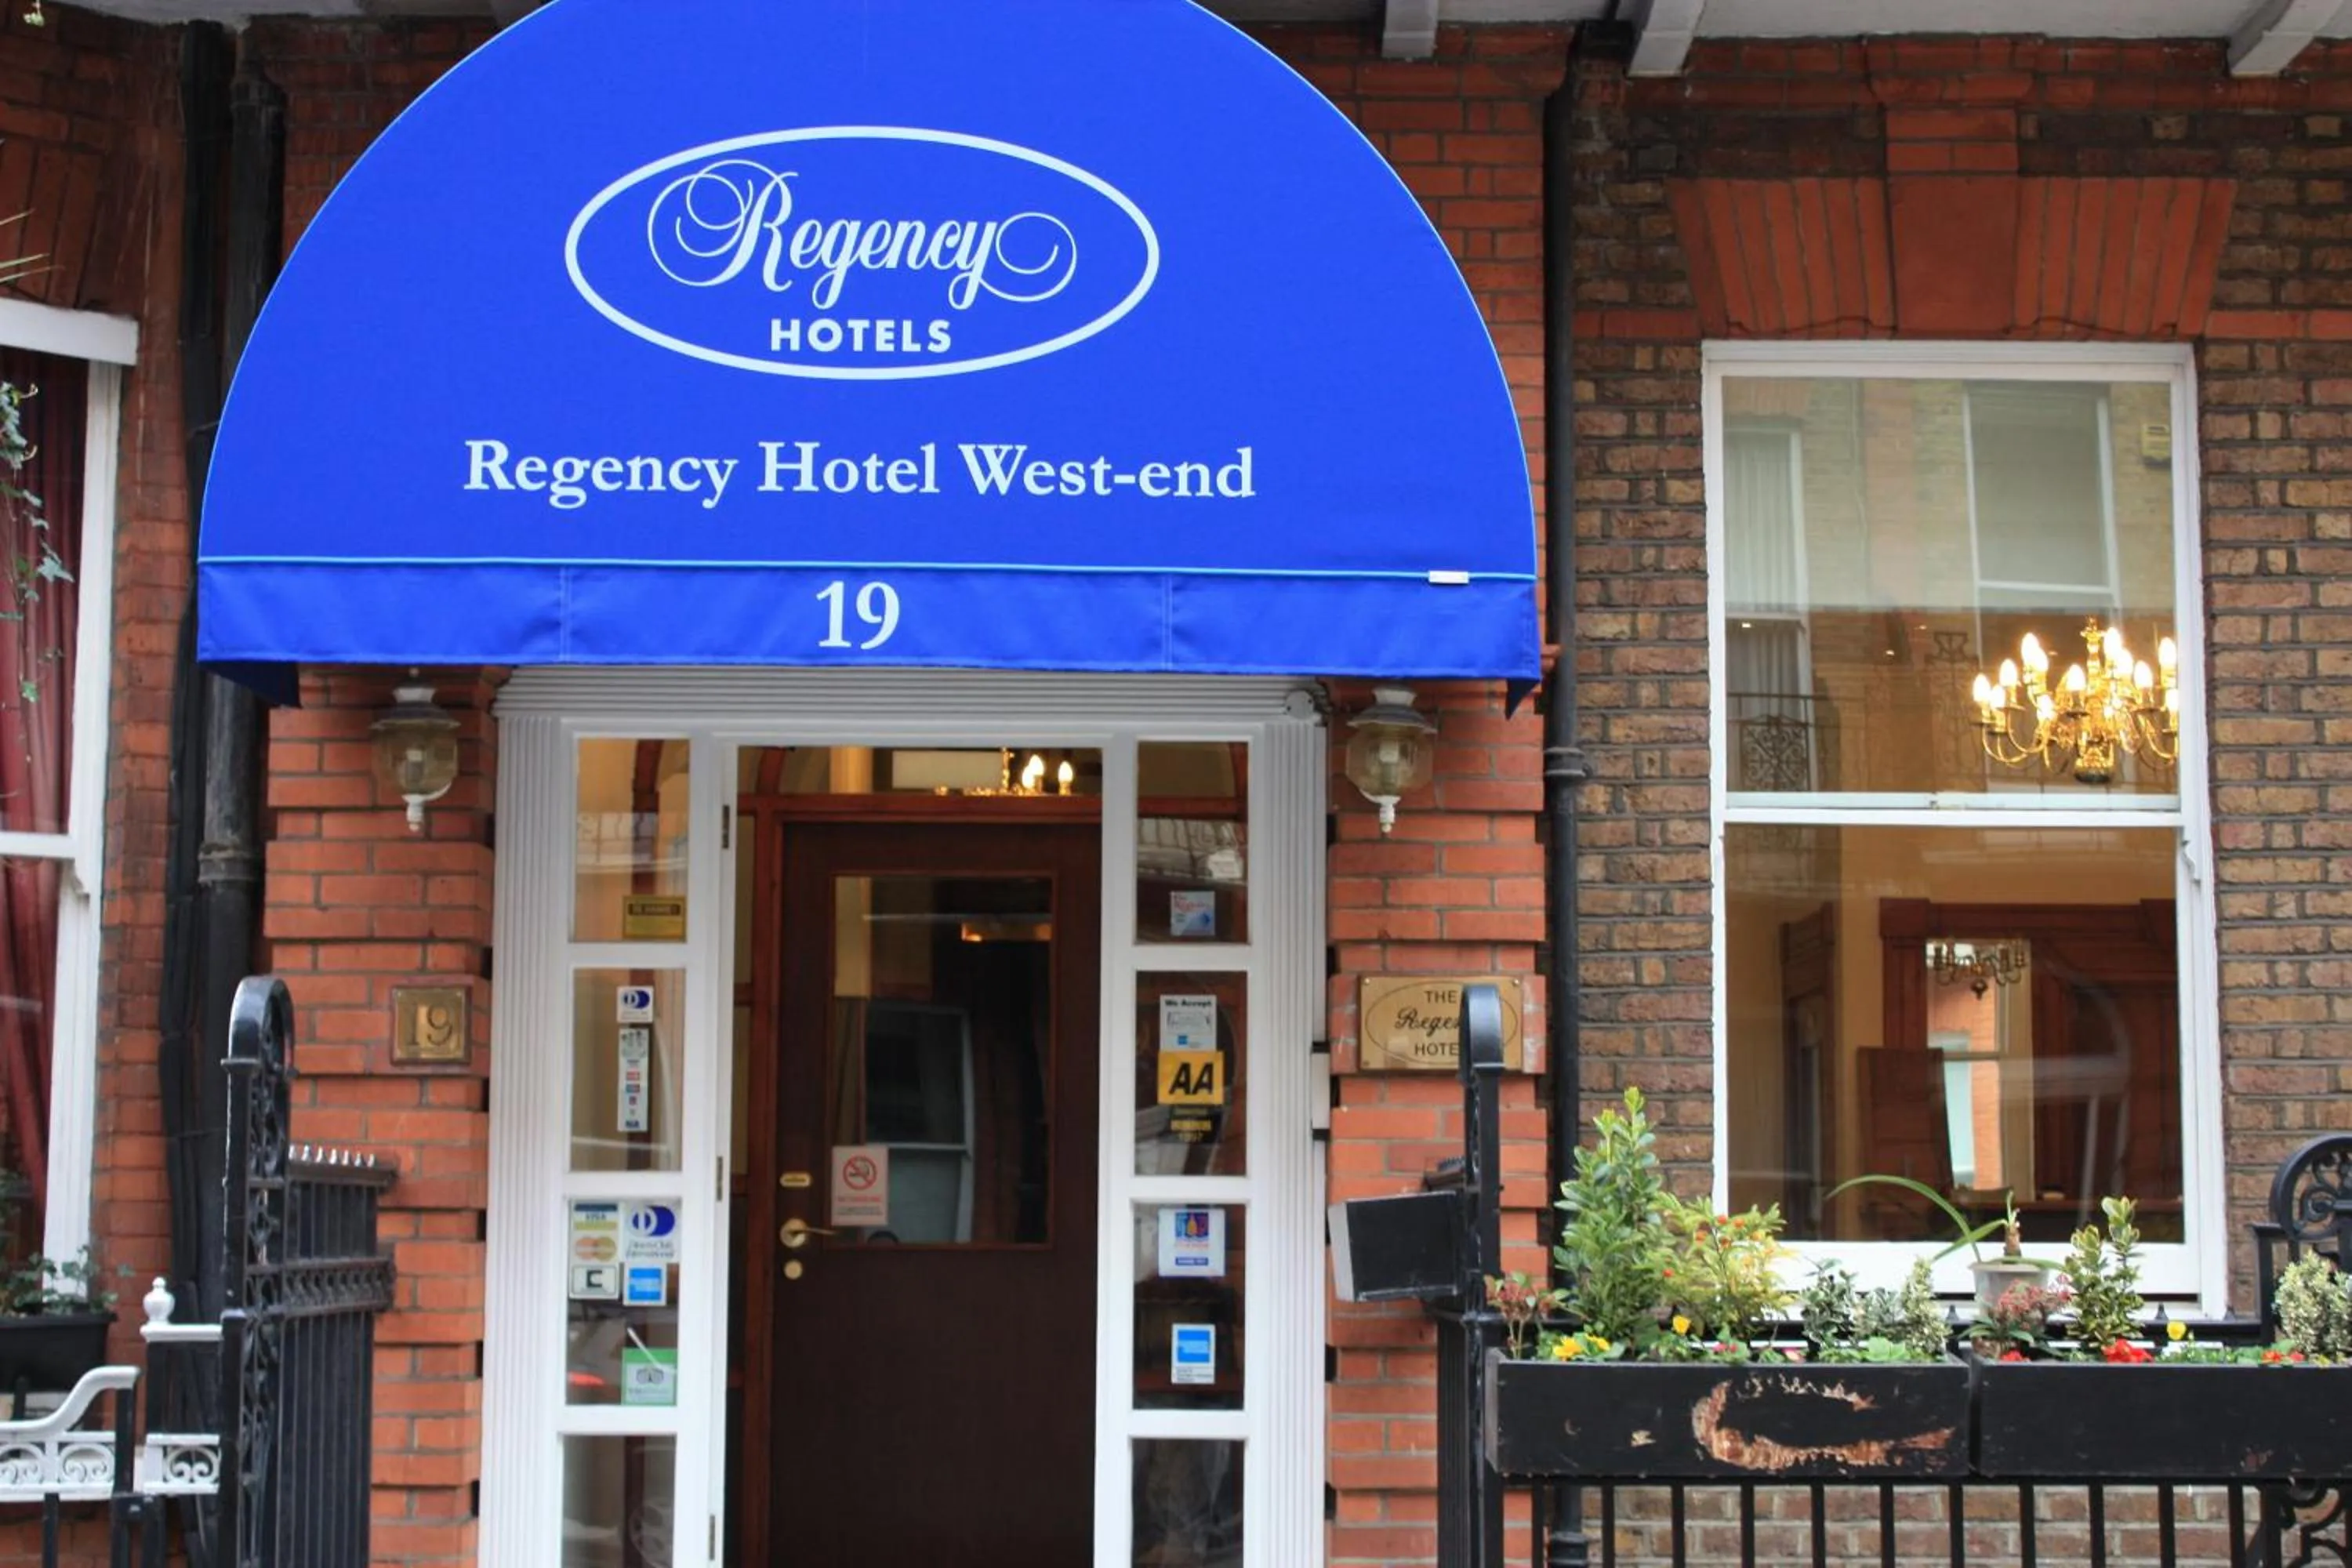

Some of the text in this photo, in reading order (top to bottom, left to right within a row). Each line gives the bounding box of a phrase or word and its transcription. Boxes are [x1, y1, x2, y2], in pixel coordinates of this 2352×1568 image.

[648, 159, 1077, 310] Regency
[771, 318, 952, 353] HOTELS
[464, 440, 1256, 510] Regency Hotel West-end
[816, 581, 900, 651] 19
[1425, 990, 1457, 1004] THE
[406, 1004, 453, 1047] 19
[1414, 1042, 1461, 1056] HOTE
[1168, 1062, 1214, 1095] AA
